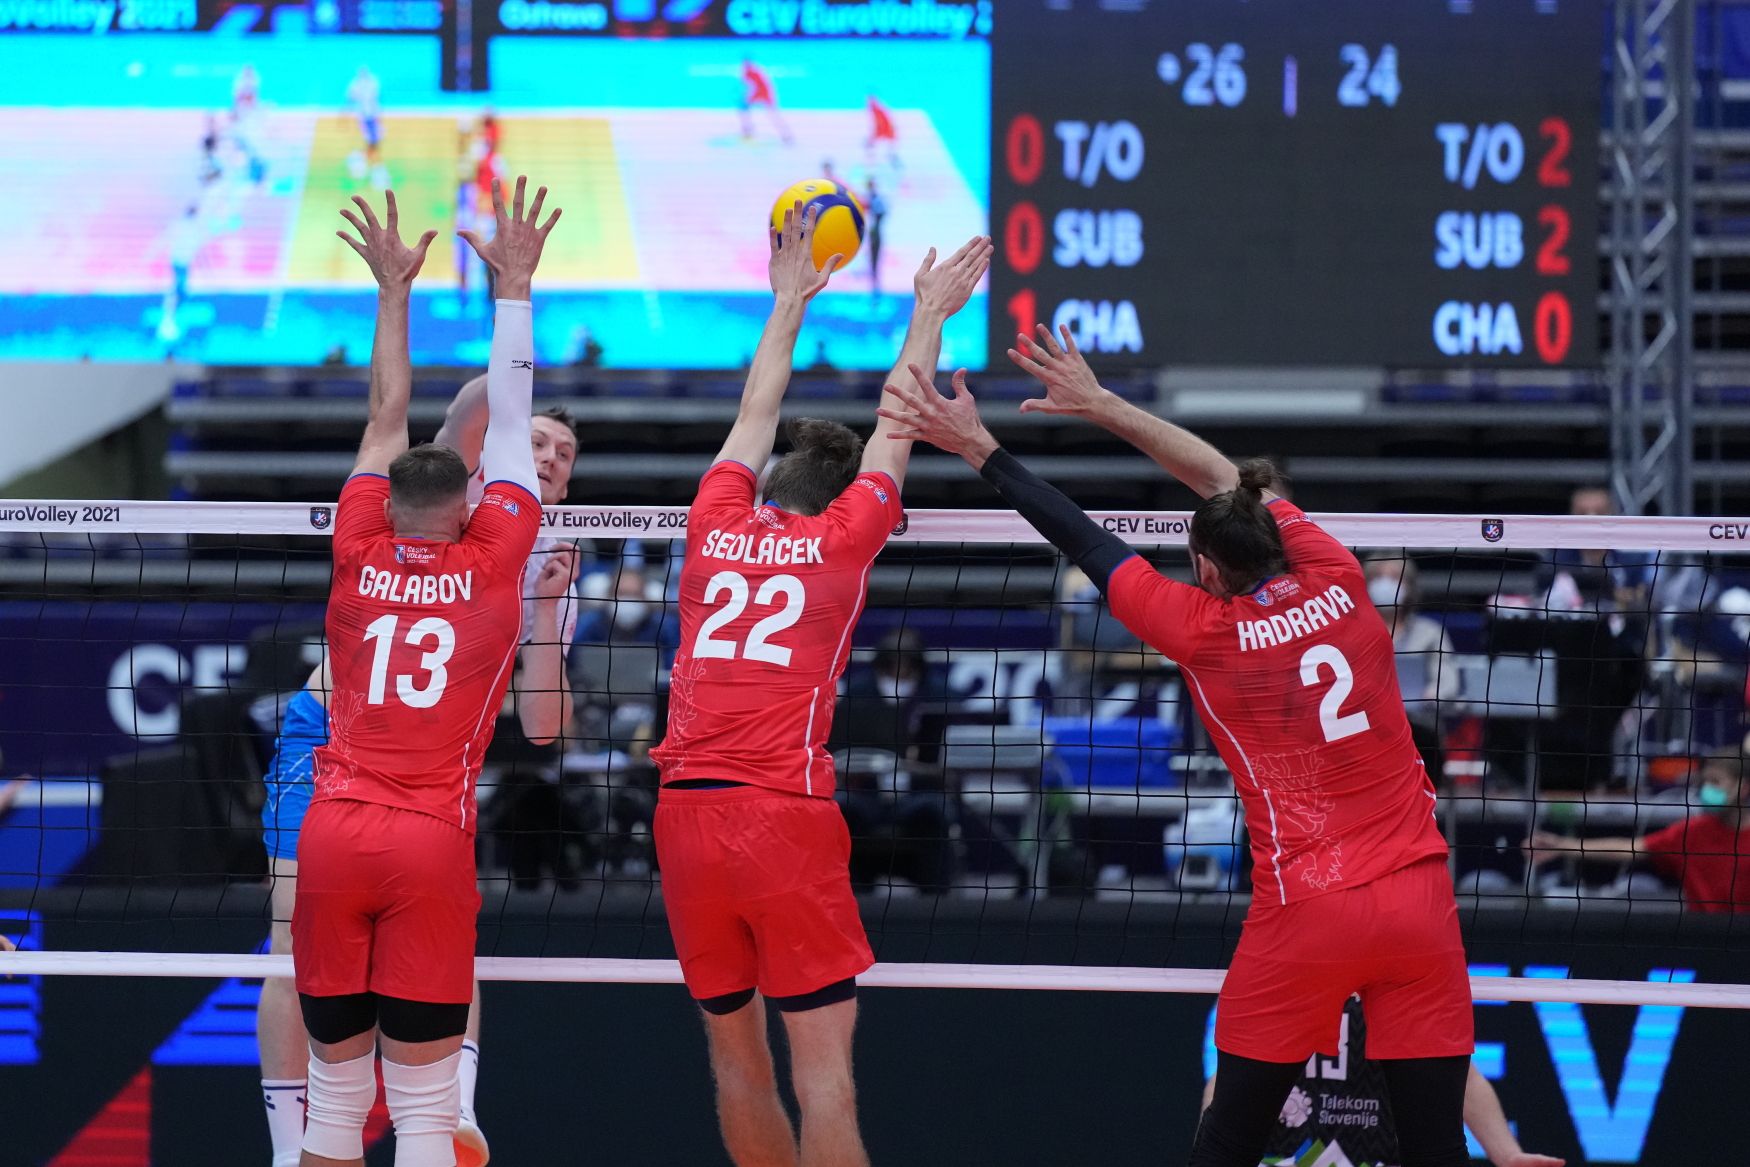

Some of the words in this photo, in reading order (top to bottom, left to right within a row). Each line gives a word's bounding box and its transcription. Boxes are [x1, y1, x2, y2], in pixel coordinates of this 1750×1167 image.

[726, 0, 799, 35] CEV
[801, 0, 976, 40] EuroVolley
[1182, 43, 1247, 107] 26
[1337, 43, 1401, 107] 24
[1006, 113, 1044, 186] 0
[1054, 119, 1144, 188] T/O
[1434, 121, 1525, 191] T/O
[1537, 116, 1571, 188] 2
[1005, 202, 1044, 276] 0
[1053, 208, 1144, 268] SUB
[1433, 209, 1524, 271] SUB
[1536, 204, 1571, 277] 2
[1007, 288, 1037, 359] 1
[1052, 298, 1143, 354] CHA
[1432, 300, 1523, 356] CHA
[1534, 290, 1572, 365] 0
[0, 506, 78, 525] uroVolley
[82, 507, 120, 522] 2021
[562, 511, 652, 531] EuroVolley
[657, 512, 688, 528] 202
[701, 529, 824, 565] SEDLÁČEK
[1103, 518, 1140, 533] CEV
[1709, 524, 1749, 540] CEV
[358, 565, 472, 605] GALABOV
[692, 570, 806, 668] 22
[1236, 584, 1355, 652] HADRAVA
[363, 614, 456, 709] 13
[1299, 644, 1371, 743] 2
[1318, 1111, 1379, 1129] Slovenije
[1320, 1094, 1379, 1111] Telekom
